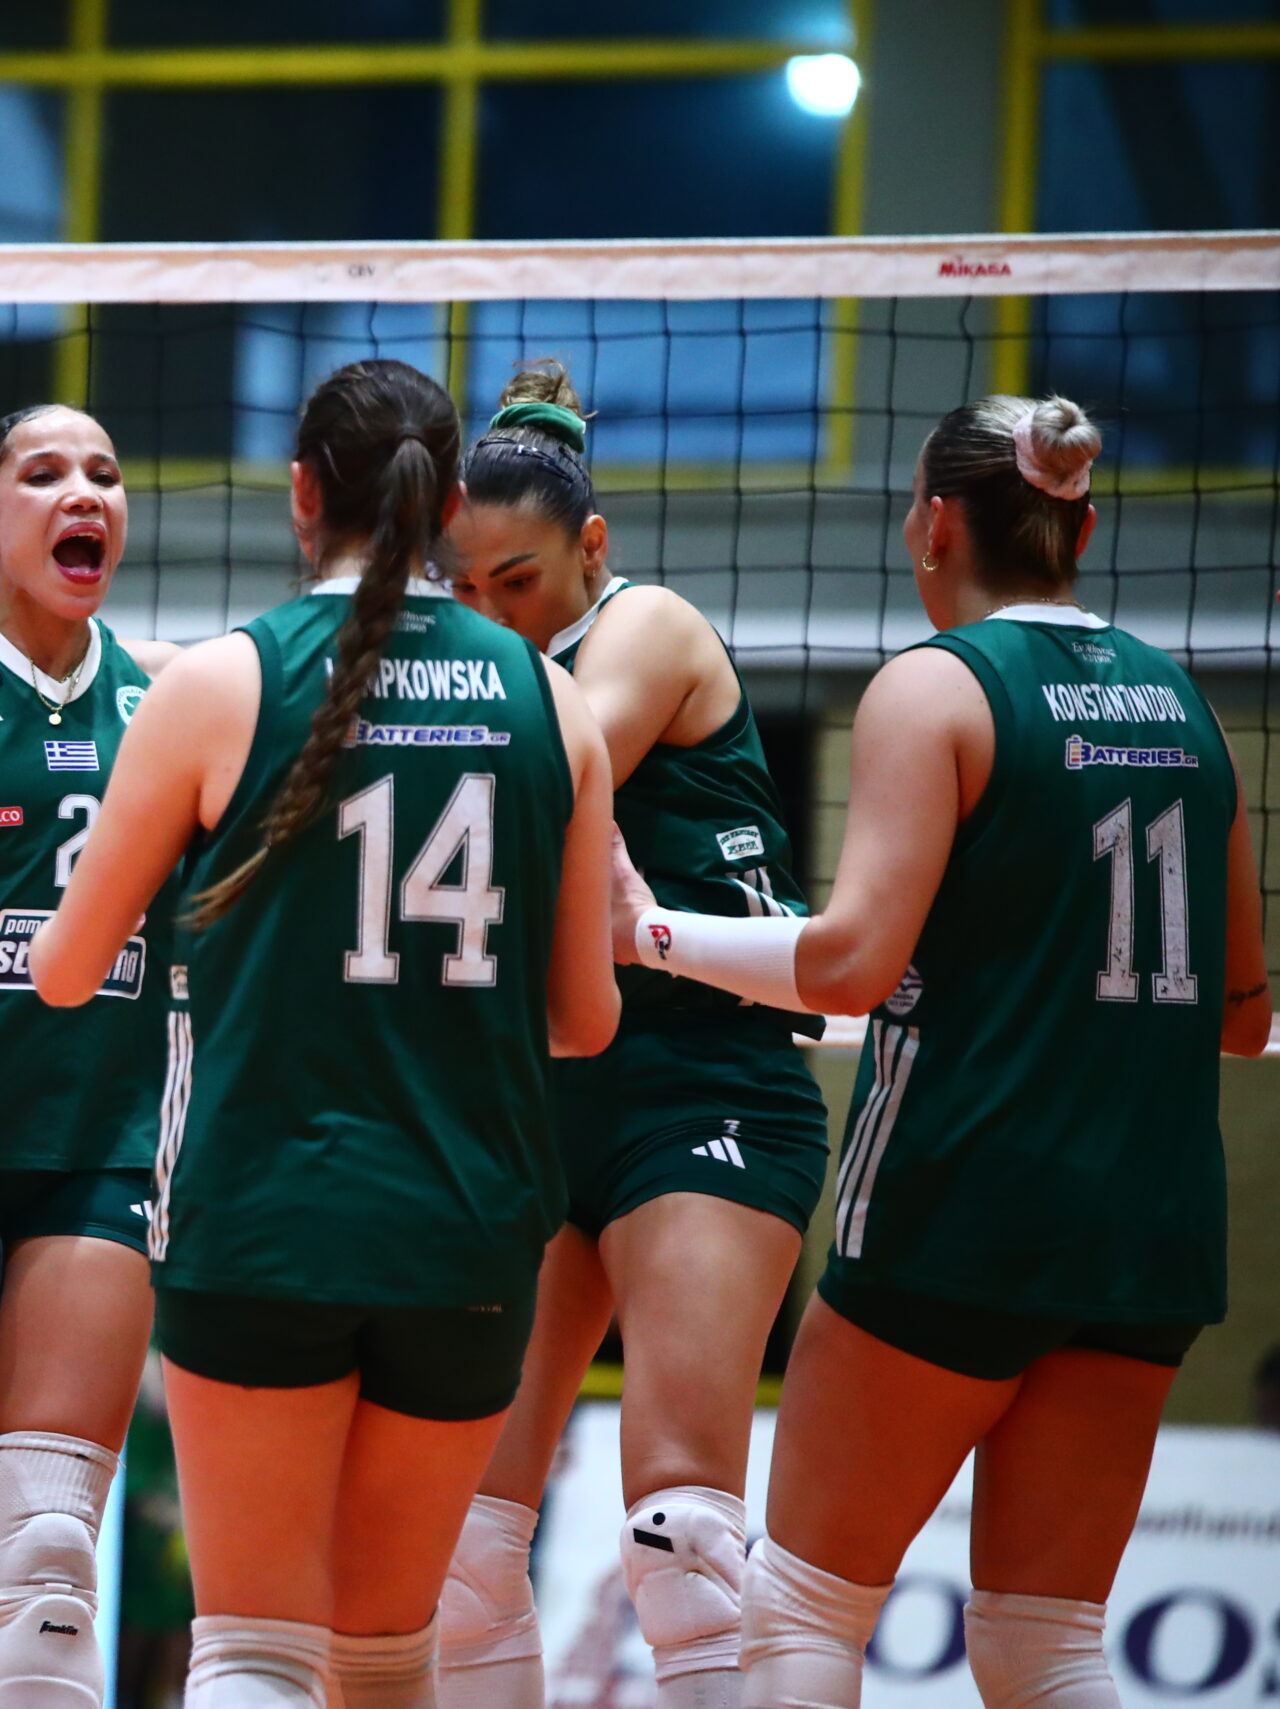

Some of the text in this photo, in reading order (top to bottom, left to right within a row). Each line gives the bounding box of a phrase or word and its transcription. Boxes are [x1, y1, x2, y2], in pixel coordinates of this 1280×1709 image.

[1042, 683, 1186, 723] KONSTANTINIDOU
[337, 773, 506, 987] 14
[1092, 797, 1198, 1004] 11
[4, 918, 43, 935] pam
[39, 1621, 78, 1636] Franklin
